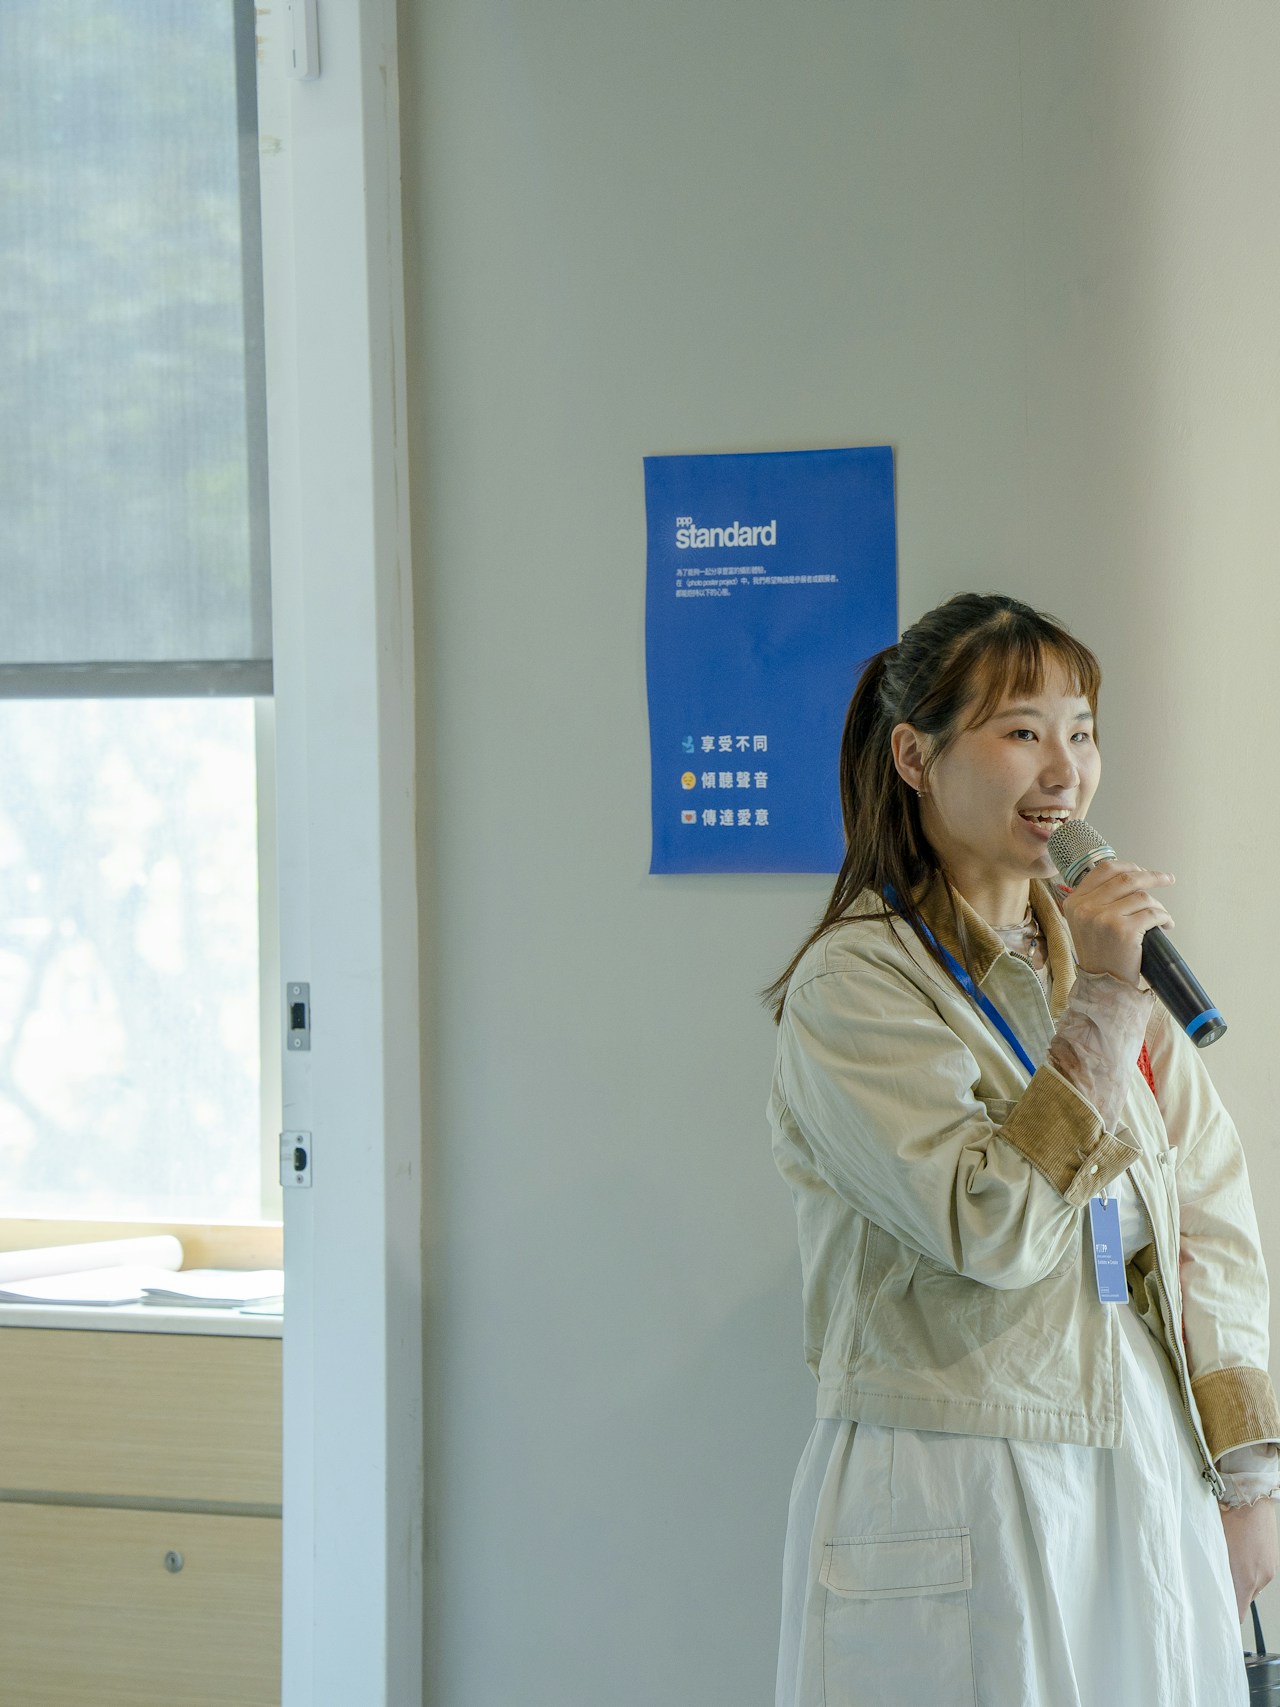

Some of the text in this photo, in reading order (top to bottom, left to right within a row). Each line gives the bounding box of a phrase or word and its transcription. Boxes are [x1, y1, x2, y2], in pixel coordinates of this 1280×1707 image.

[676, 516, 693, 527] ppp
[675, 519, 777, 549] standard
[701, 734, 768, 753] 享受不同
[701, 771, 769, 789] 傾聽聲音
[701, 808, 770, 827] 傳達愛意
